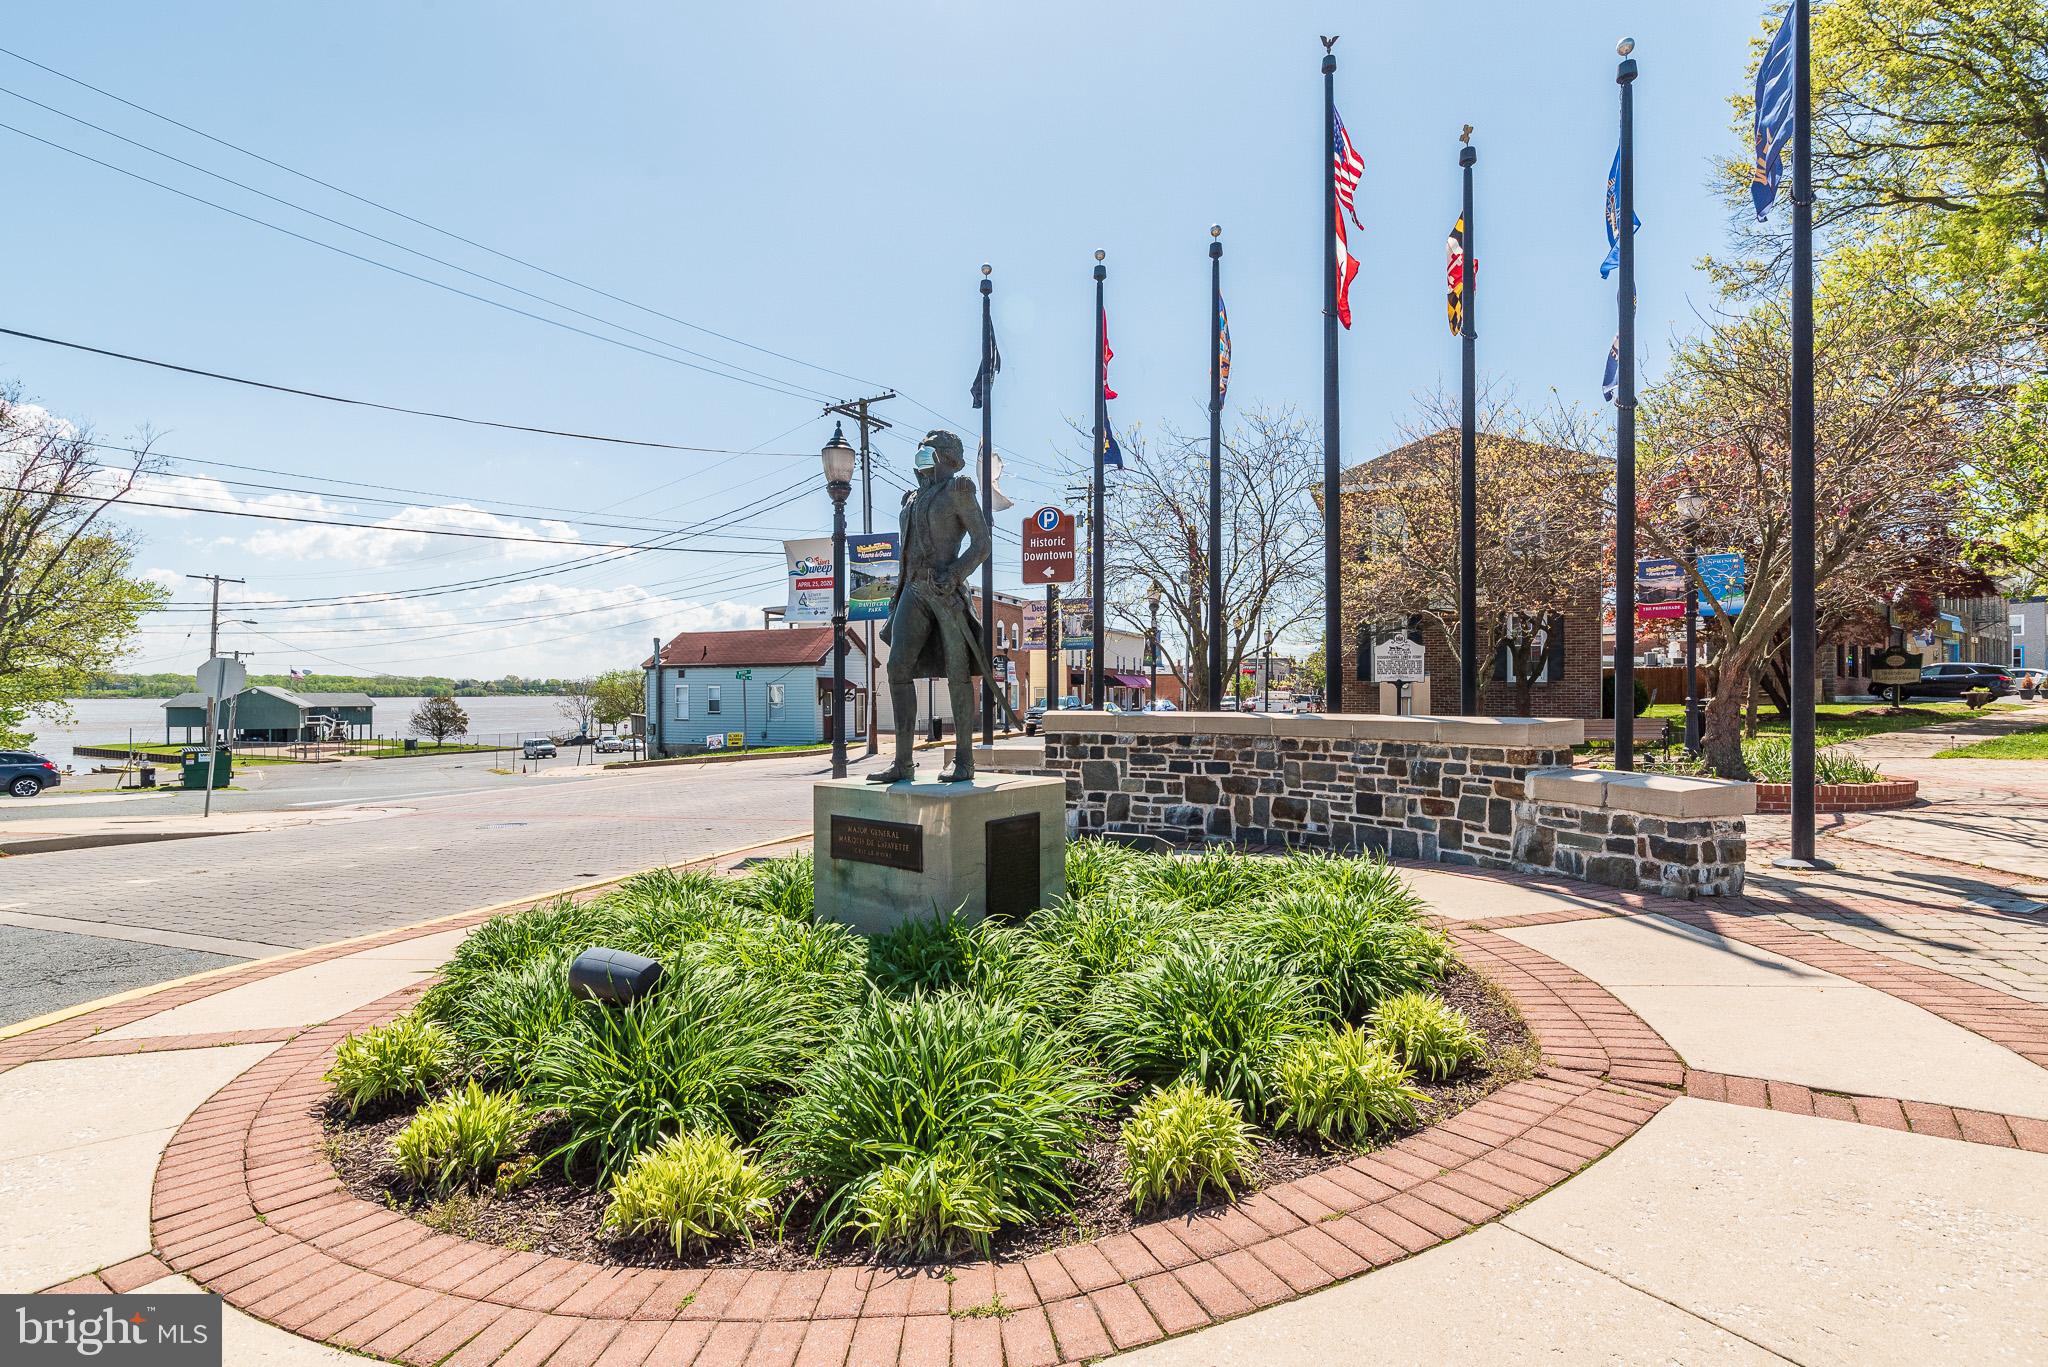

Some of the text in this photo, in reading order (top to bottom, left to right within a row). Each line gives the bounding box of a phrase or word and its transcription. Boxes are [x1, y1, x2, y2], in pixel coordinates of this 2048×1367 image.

[1043, 511, 1055, 528] P
[1030, 536, 1066, 548] Historic
[1024, 551, 1073, 561] Downtown
[795, 560, 833, 576] Sweep
[1031, 603, 1047, 612] Deco
[848, 825, 900, 839] MAJOR GENERAL
[839, 835, 865, 845] MARQUIS
[866, 839, 875, 847] DE
